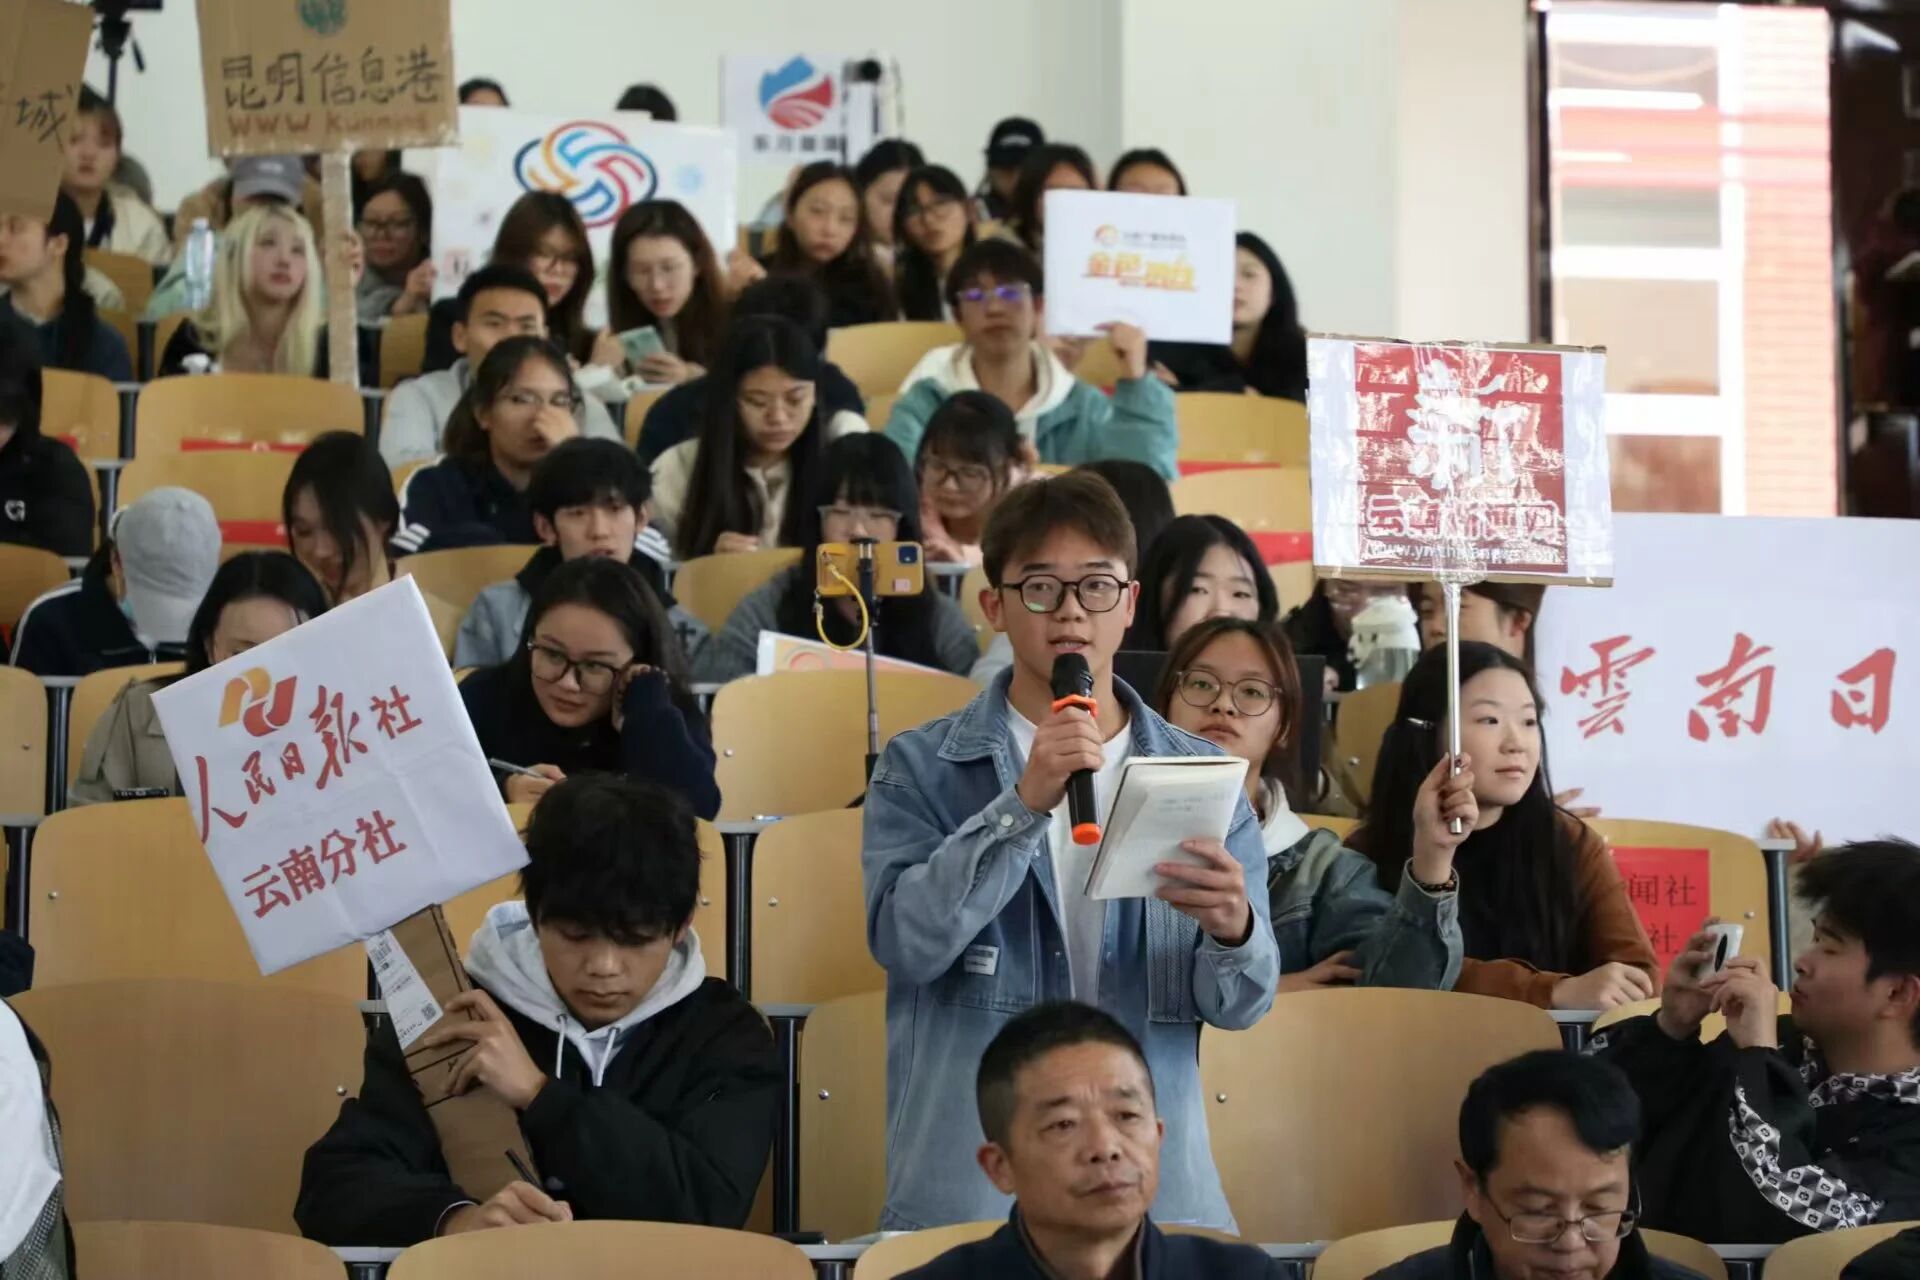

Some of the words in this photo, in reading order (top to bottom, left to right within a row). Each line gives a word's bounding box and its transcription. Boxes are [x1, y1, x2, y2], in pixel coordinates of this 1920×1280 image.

[222, 44, 444, 110] 昆明信息港
[242, 810, 407, 919] 云南分社
